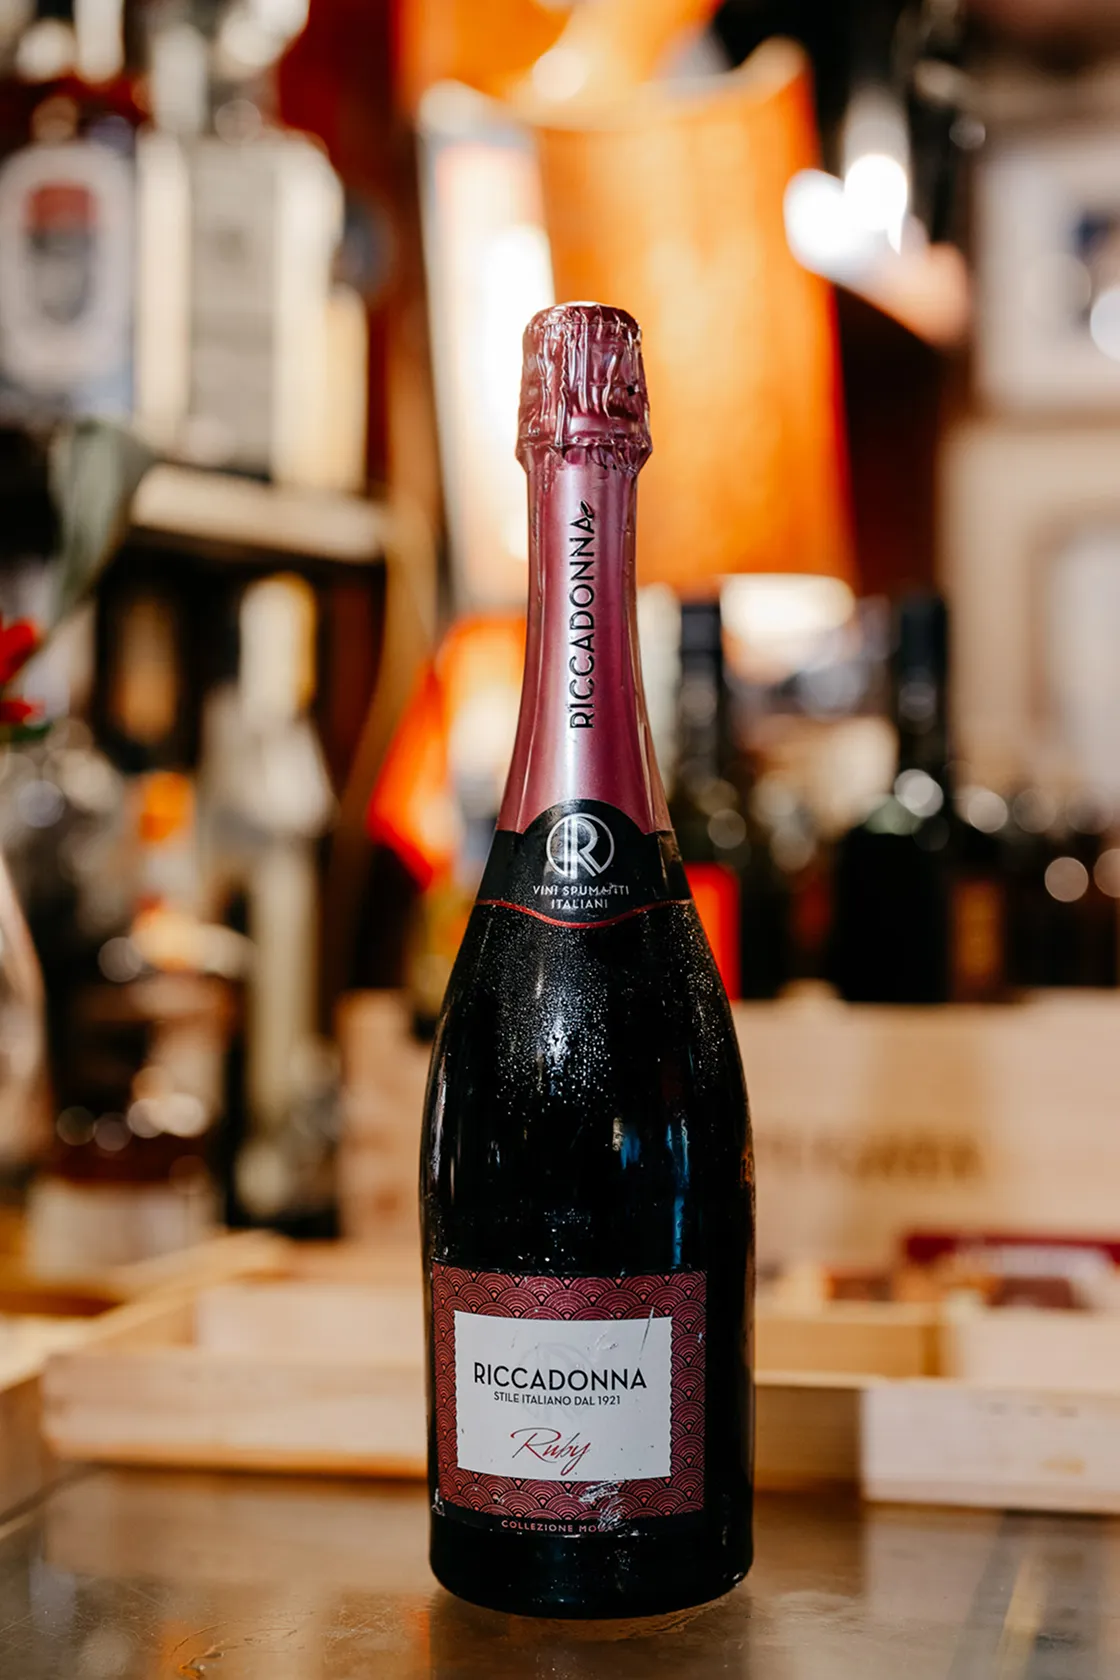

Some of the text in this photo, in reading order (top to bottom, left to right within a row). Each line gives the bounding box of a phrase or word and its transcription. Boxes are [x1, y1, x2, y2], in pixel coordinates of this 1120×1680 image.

[569, 501, 595, 729] RICCADONNA
[532, 885, 558, 896] VINI
[551, 899, 608, 909] ITALIANI
[474, 1362, 647, 1391] RICCADONNA
[493, 1391, 621, 1406] STILE ITALIANO DAL 1921
[510, 1427, 591, 1476] Ruby
[501, 1520, 573, 1532] COLLEZIONE
